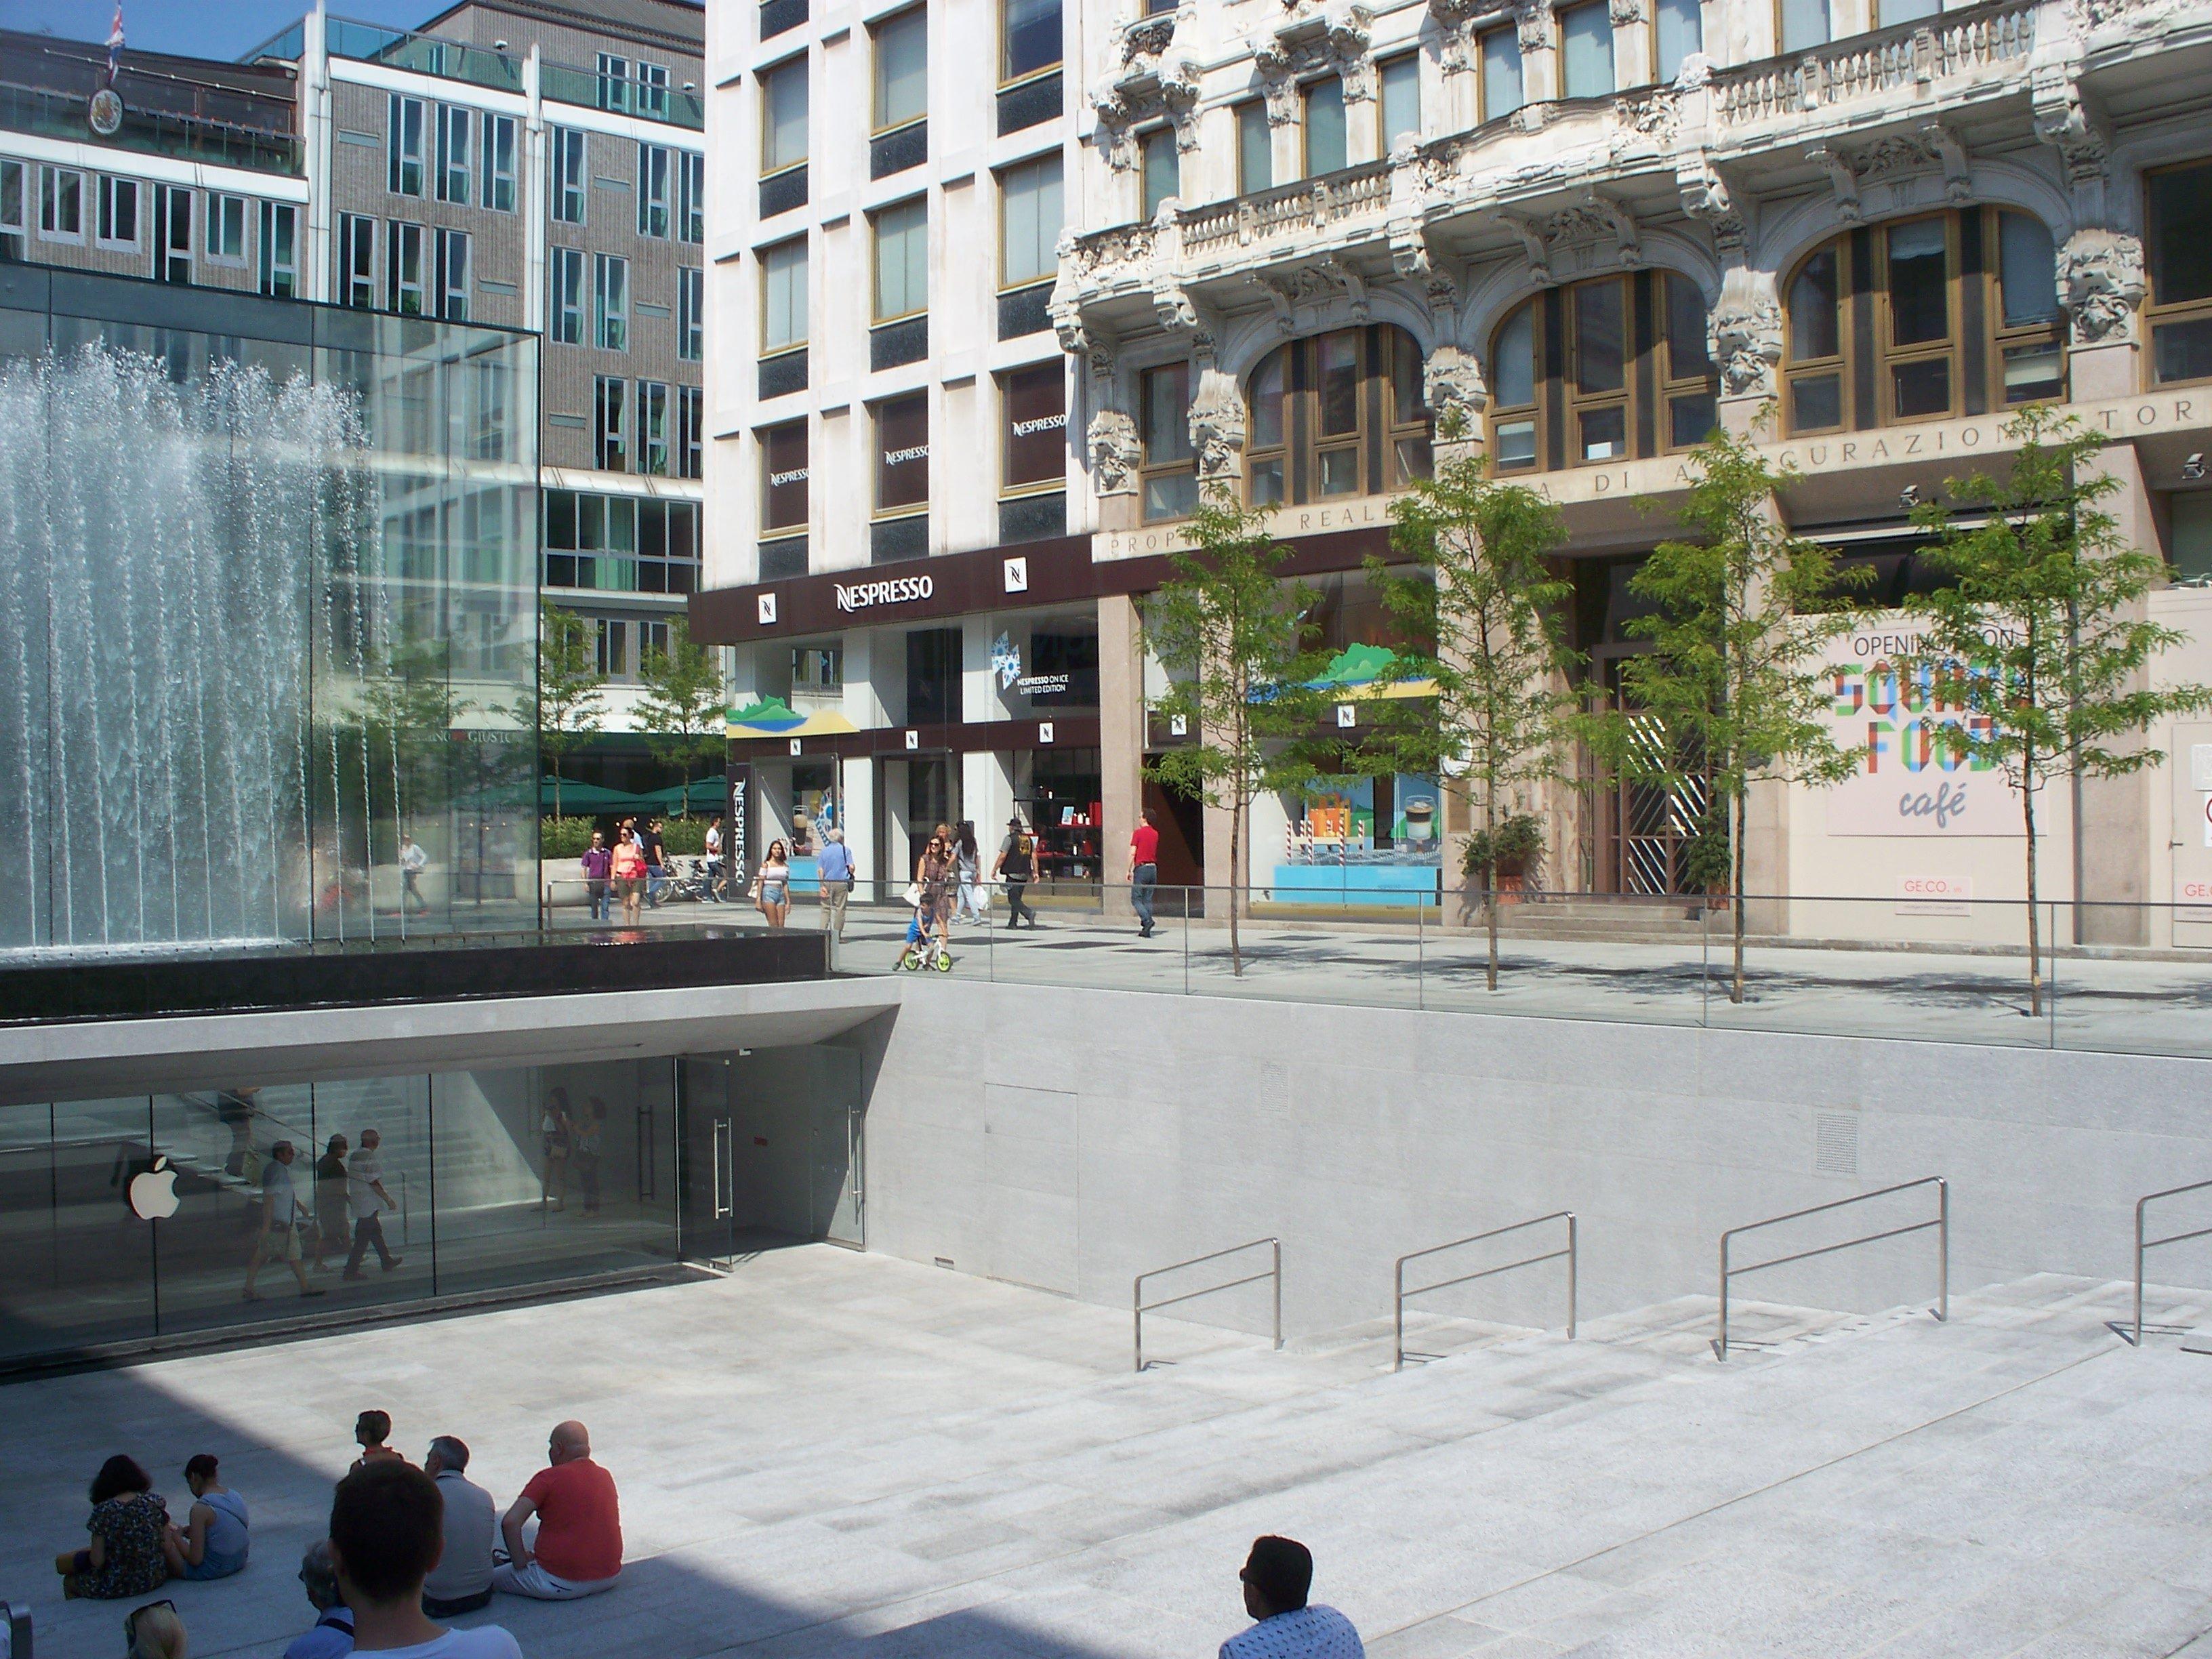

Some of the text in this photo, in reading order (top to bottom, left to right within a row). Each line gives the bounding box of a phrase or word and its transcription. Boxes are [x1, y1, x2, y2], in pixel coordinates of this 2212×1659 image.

[1011, 413, 1066, 436] NESPRESSO
[1300, 501, 1397, 529] REALE
[1595, 471, 1628, 492] DI
[834, 575, 933, 613] NESPRESSO
[1017, 674, 1069, 687] NESPRESSO ON ICE
[1020, 684, 1066, 695] LIMITED EDITION
[1899, 781, 1967, 829] café
[733, 777, 746, 884] NESPRESSO
[2185, 884, 2212, 897] GE.
